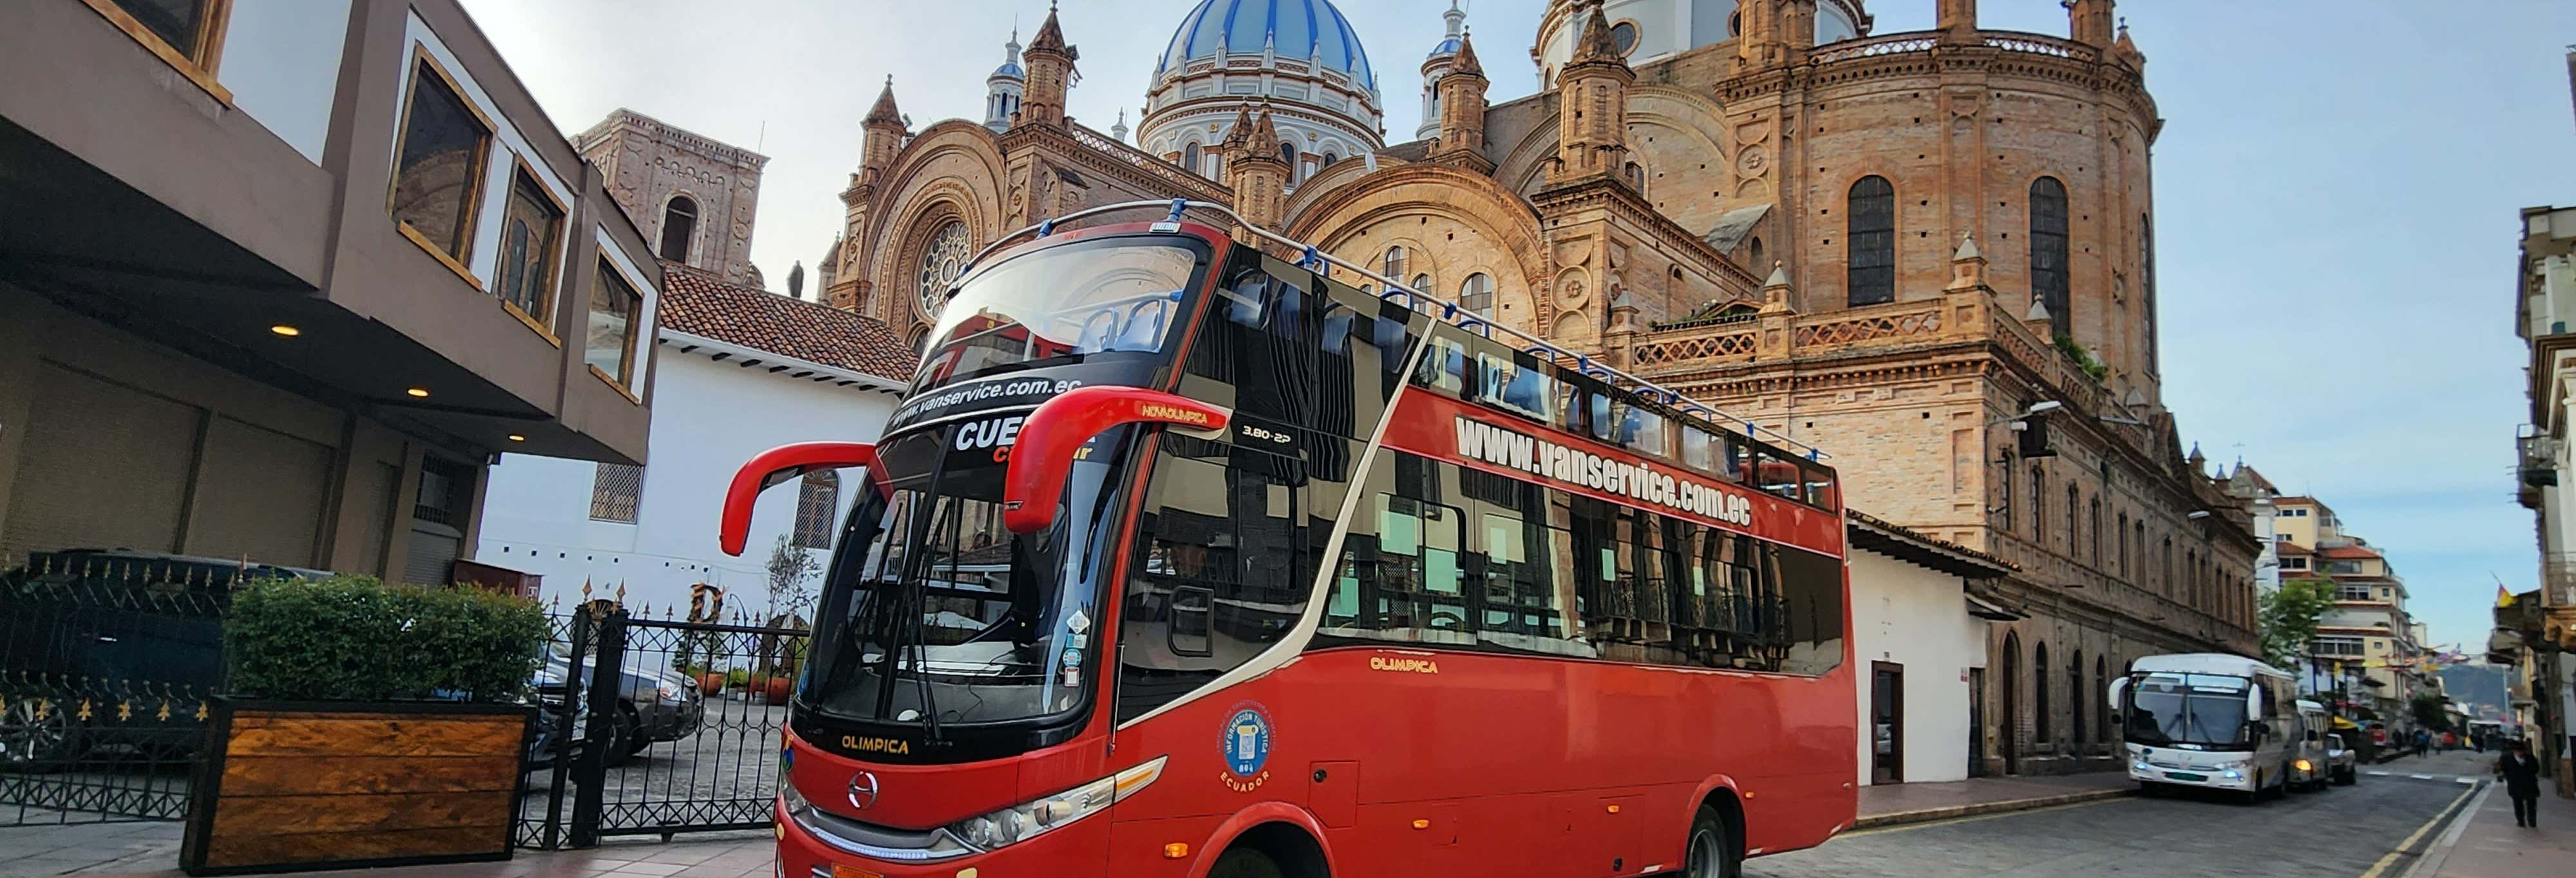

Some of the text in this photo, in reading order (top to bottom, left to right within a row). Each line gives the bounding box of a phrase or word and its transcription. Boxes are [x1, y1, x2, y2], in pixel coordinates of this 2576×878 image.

[1455, 416, 1751, 527] www.vanservice.com.ec
[1370, 656, 1439, 674] OLIMPICA
[842, 735, 909, 755] OLIMPICA
[1220, 770, 1270, 793] ECUADOR
